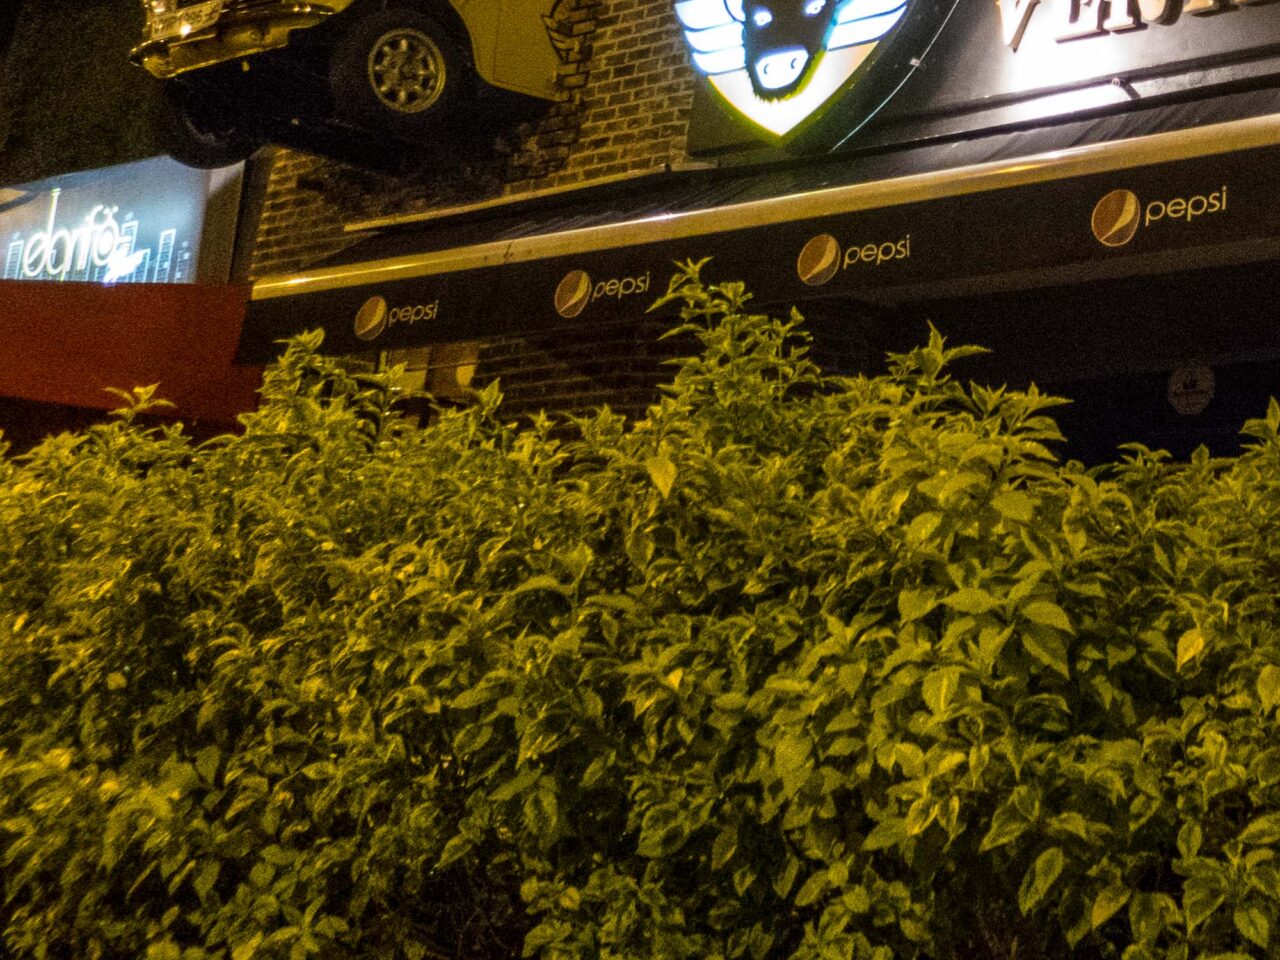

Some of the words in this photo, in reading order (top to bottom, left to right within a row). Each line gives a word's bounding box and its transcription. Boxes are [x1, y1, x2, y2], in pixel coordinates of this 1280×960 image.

[1144, 185, 1227, 227] pepsi
[842, 234, 911, 270] pepsi
[590, 271, 651, 303] pepsi
[387, 299, 440, 328] pepsi
